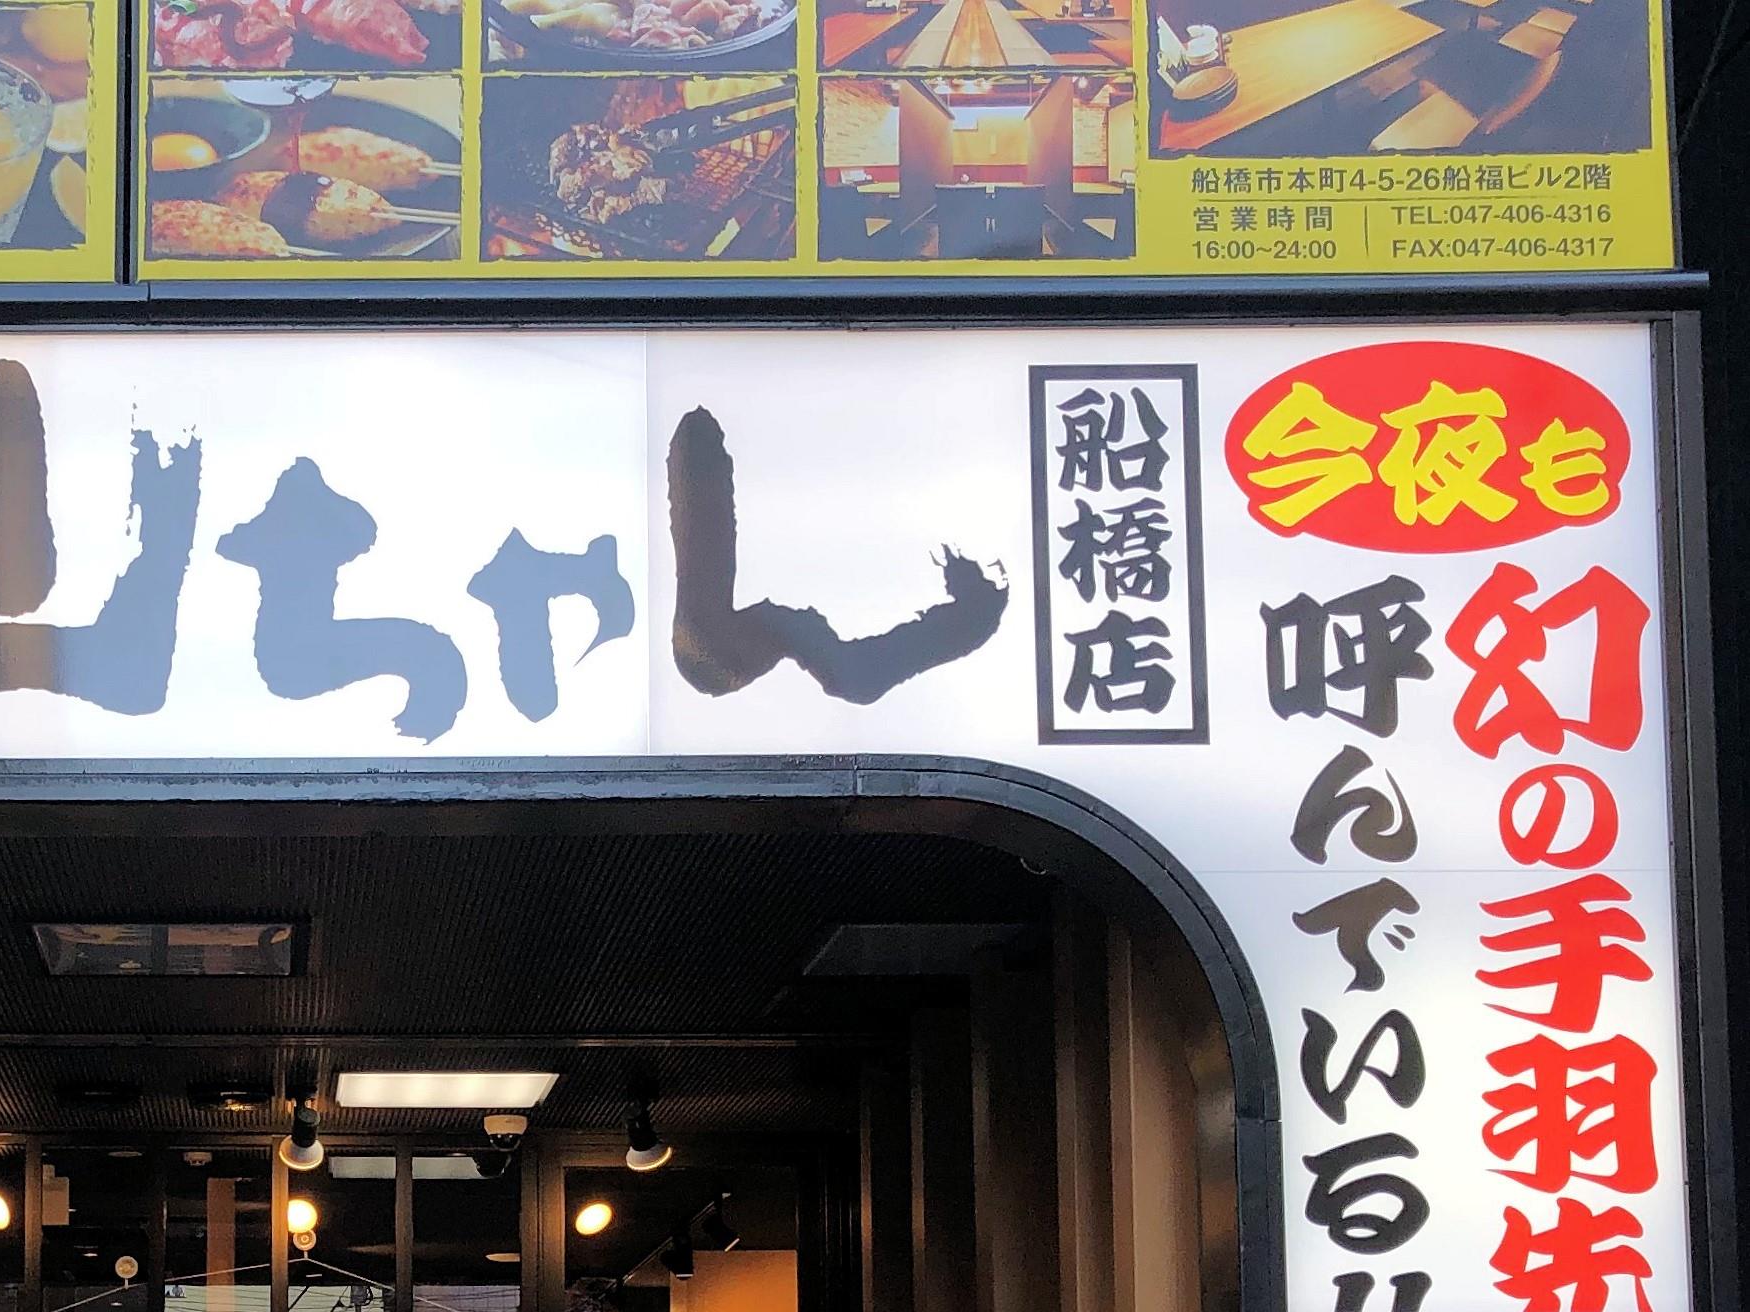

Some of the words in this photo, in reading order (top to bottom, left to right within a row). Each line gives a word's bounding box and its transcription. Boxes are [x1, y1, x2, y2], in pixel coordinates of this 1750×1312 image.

[1191, 164, 1613, 194] 船橋市本町4-5-26船福ビル2階
[1193, 206, 1334, 233] 営業時間
[1391, 205, 1612, 226] TEL:047-406-4316
[1392, 238, 1614, 259] FAX:047-406-4317
[1242, 380, 1611, 527] 今夜も
[1055, 385, 1178, 716] 船橋店
